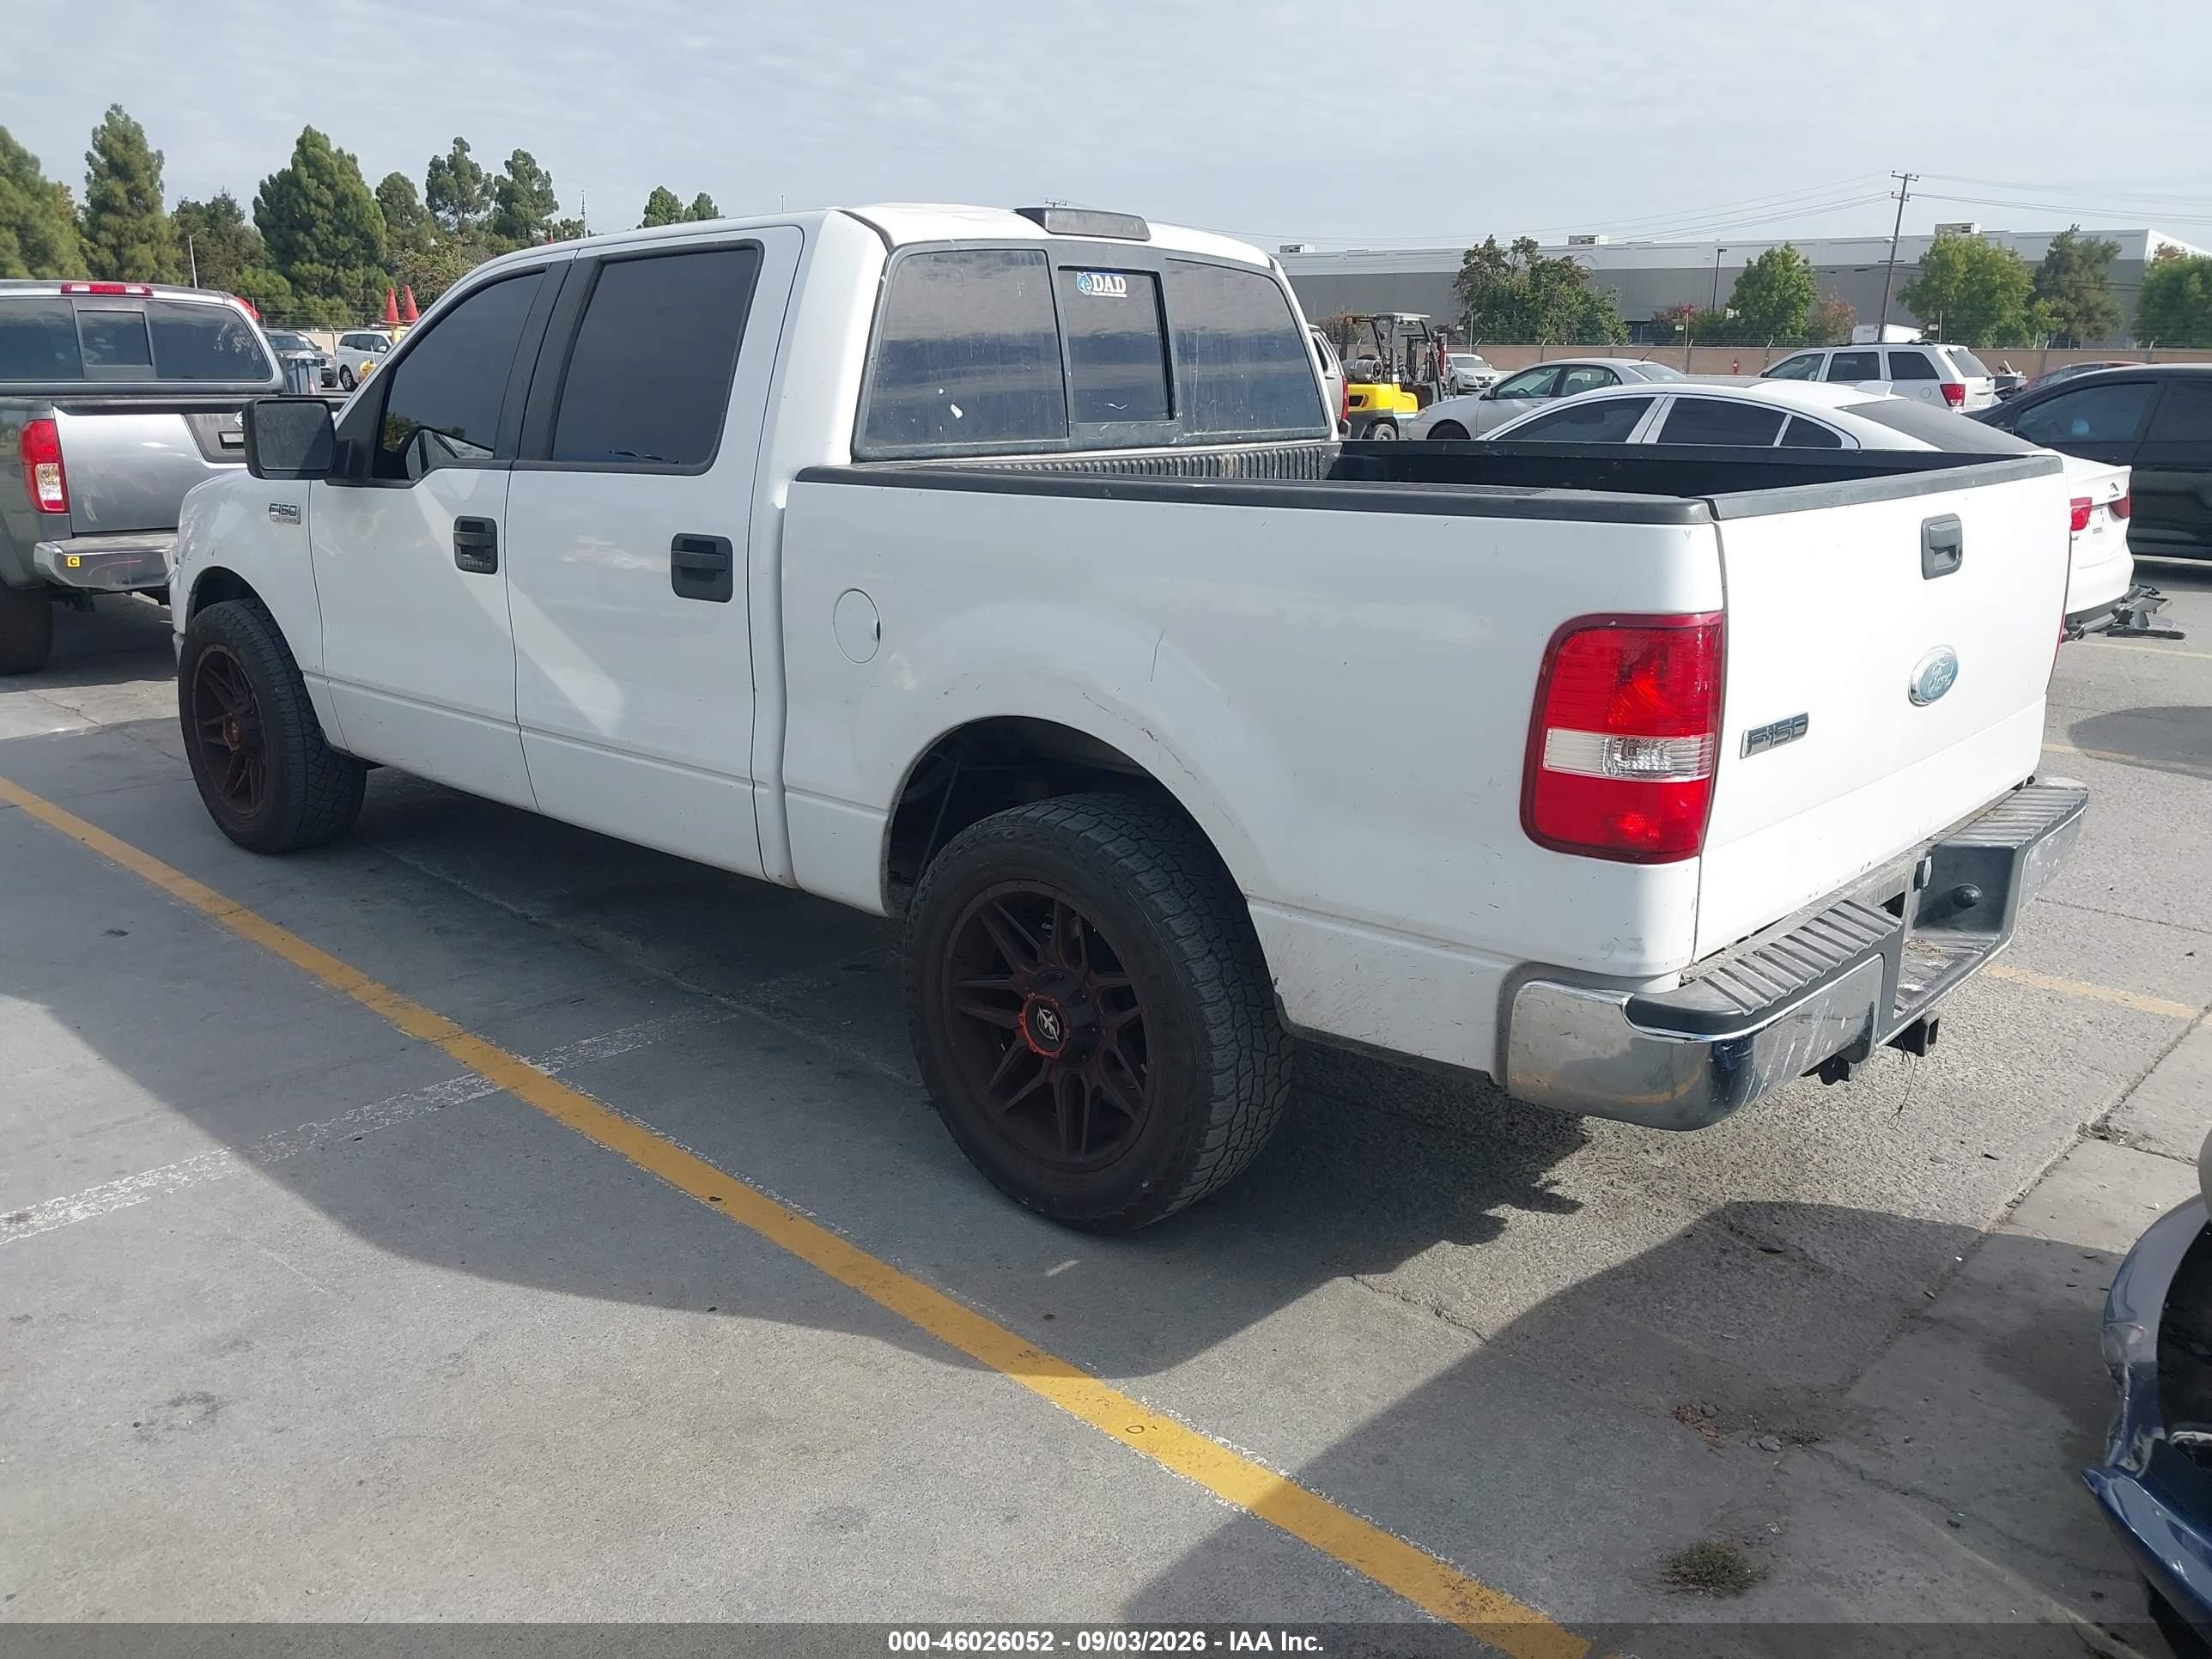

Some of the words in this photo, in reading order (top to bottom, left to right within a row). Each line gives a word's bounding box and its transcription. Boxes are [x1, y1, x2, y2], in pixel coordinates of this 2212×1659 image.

[1091, 274, 1127, 294] DAD
[70, 557, 78, 566] C
[1927, 659, 1954, 692] Ford
